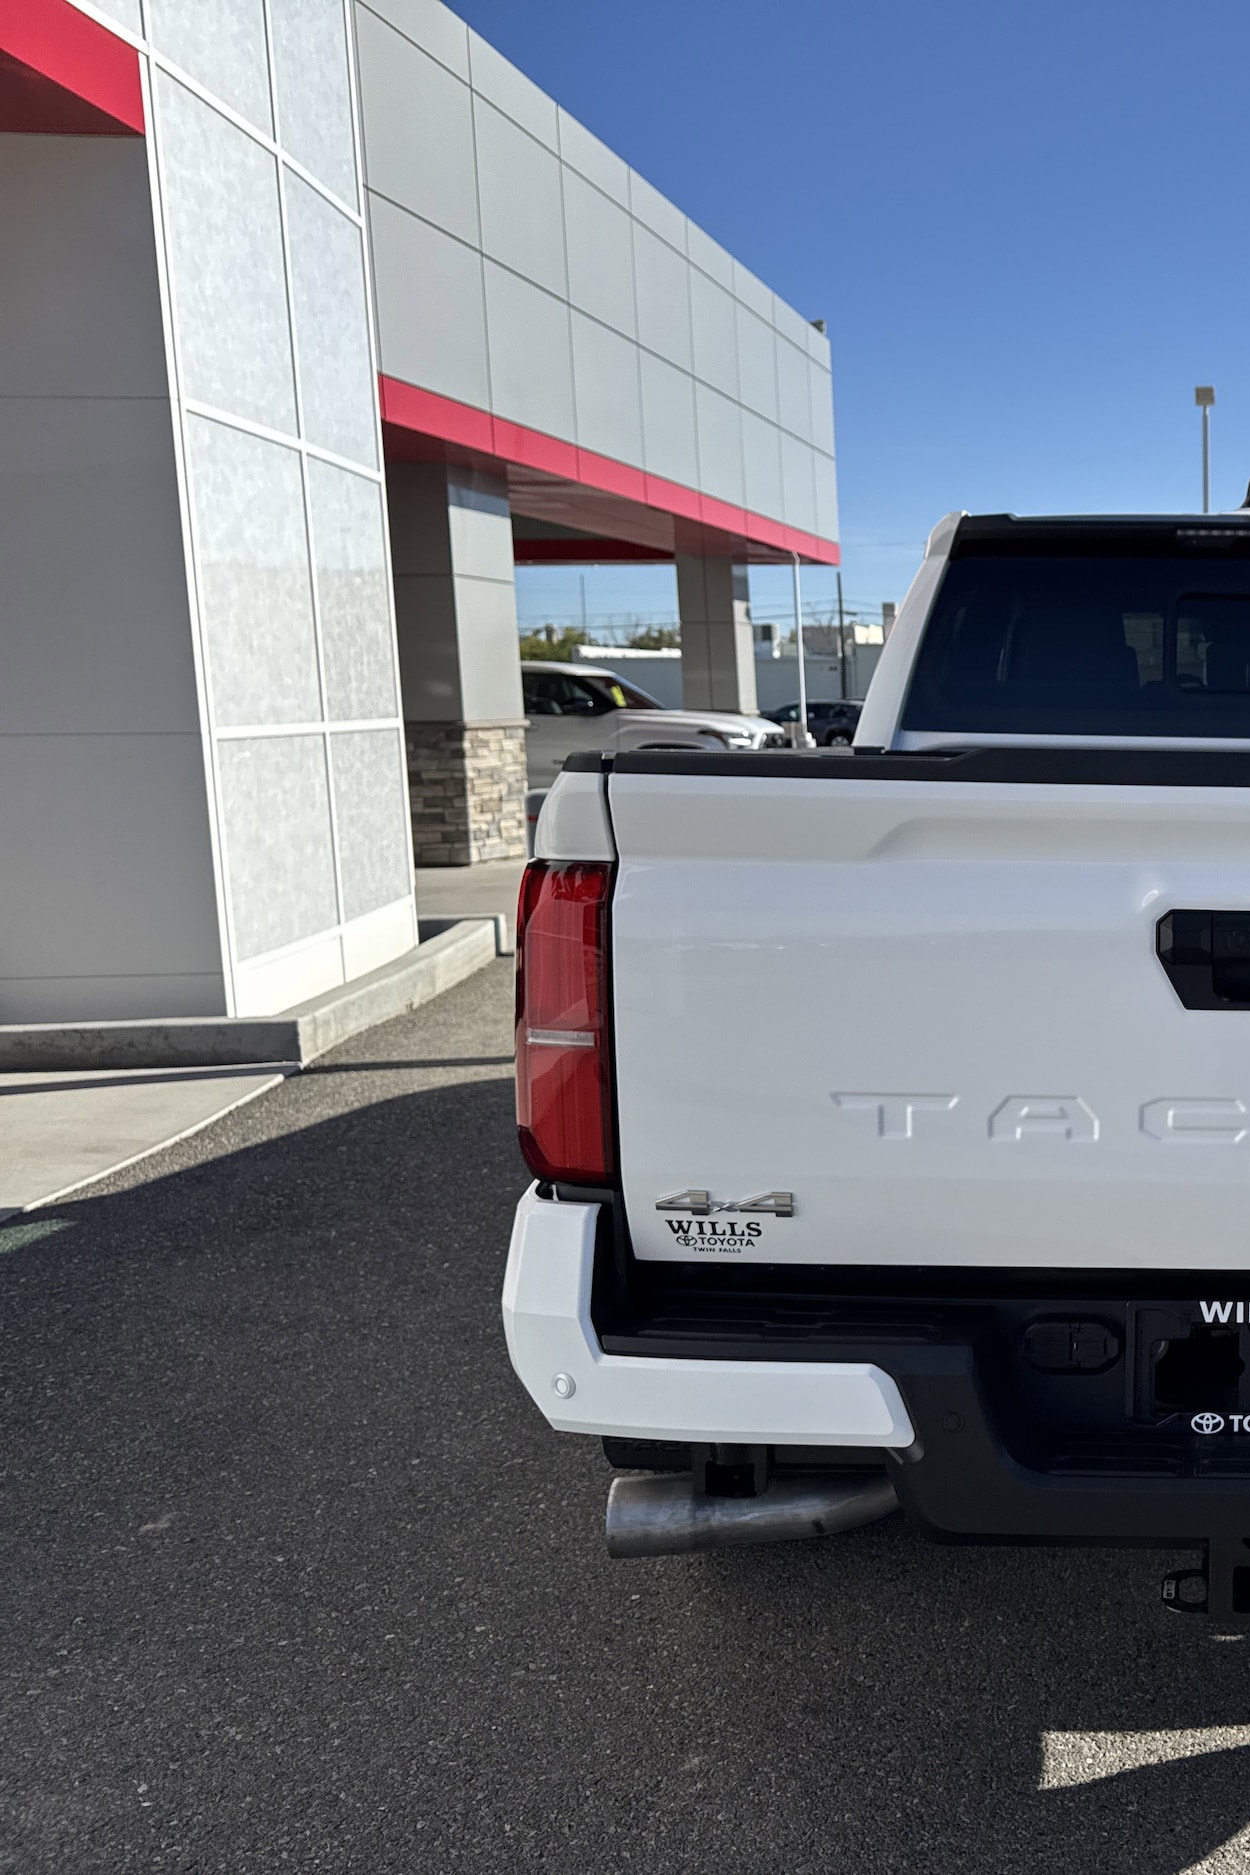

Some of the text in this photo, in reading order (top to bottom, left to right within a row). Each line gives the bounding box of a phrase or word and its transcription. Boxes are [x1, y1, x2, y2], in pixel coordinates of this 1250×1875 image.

[665, 1219, 763, 1237] WILLS
[698, 1236, 755, 1247] TOYOTA
[693, 1246, 716, 1254] TWIN
